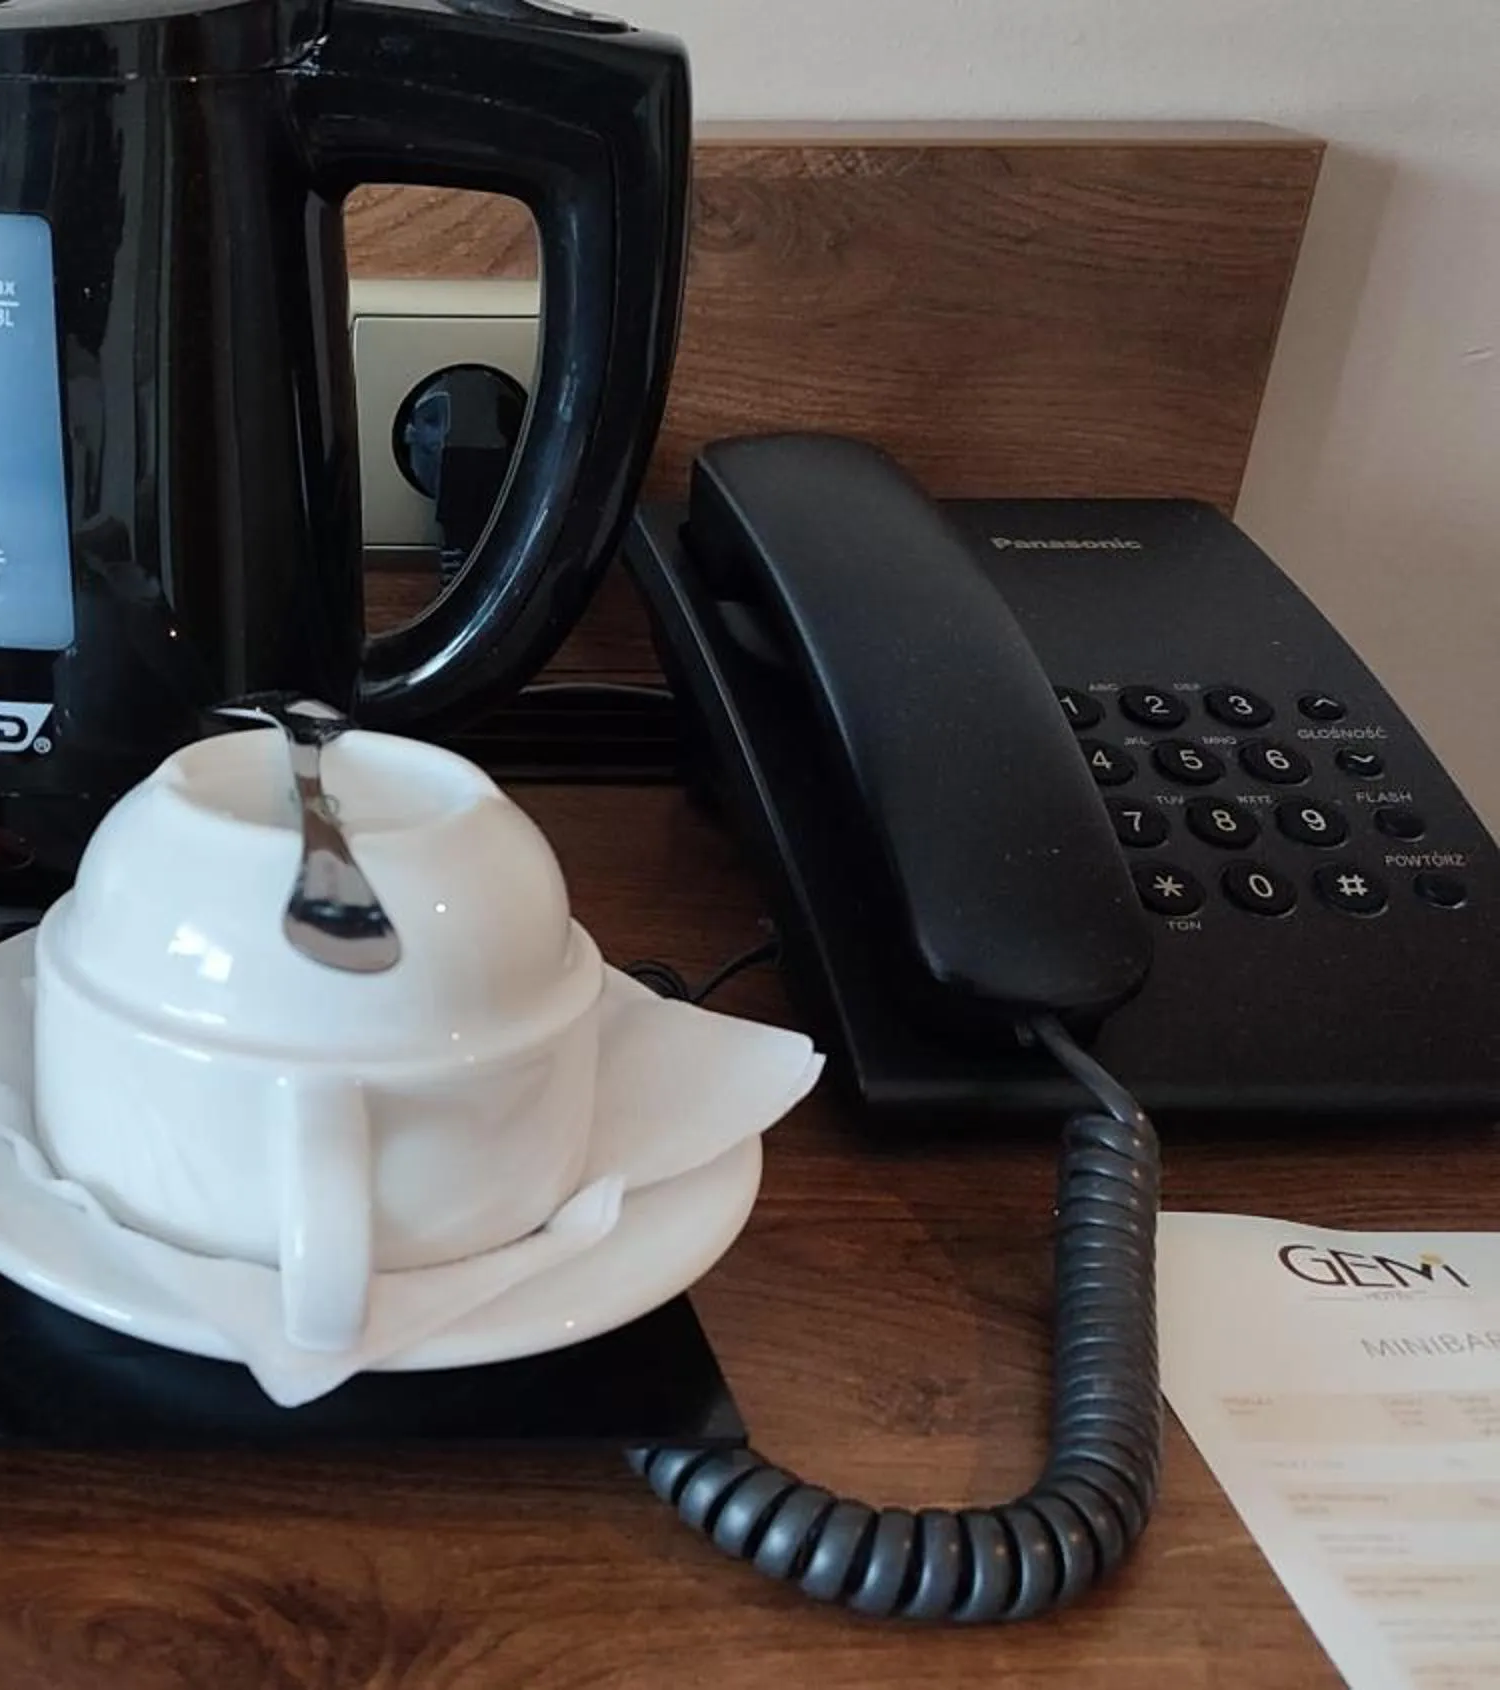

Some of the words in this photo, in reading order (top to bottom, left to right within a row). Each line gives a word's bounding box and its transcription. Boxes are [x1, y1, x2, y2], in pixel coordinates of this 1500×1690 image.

[989, 536, 1143, 550] Panasonic
[1061, 695, 1079, 716] 1
[1144, 694, 1170, 714] 2
[1228, 694, 1254, 715] 3
[1091, 749, 1114, 771] 4
[1179, 749, 1204, 771] 5
[1265, 749, 1291, 771] 6
[1355, 791, 1414, 804] FLASH
[1122, 810, 1143, 833] 7
[1211, 808, 1238, 832] 8
[1300, 808, 1328, 832] 9
[1248, 873, 1274, 899] 0
[1166, 919, 1203, 931] TON
[1277, 1243, 1472, 1289] GEM
